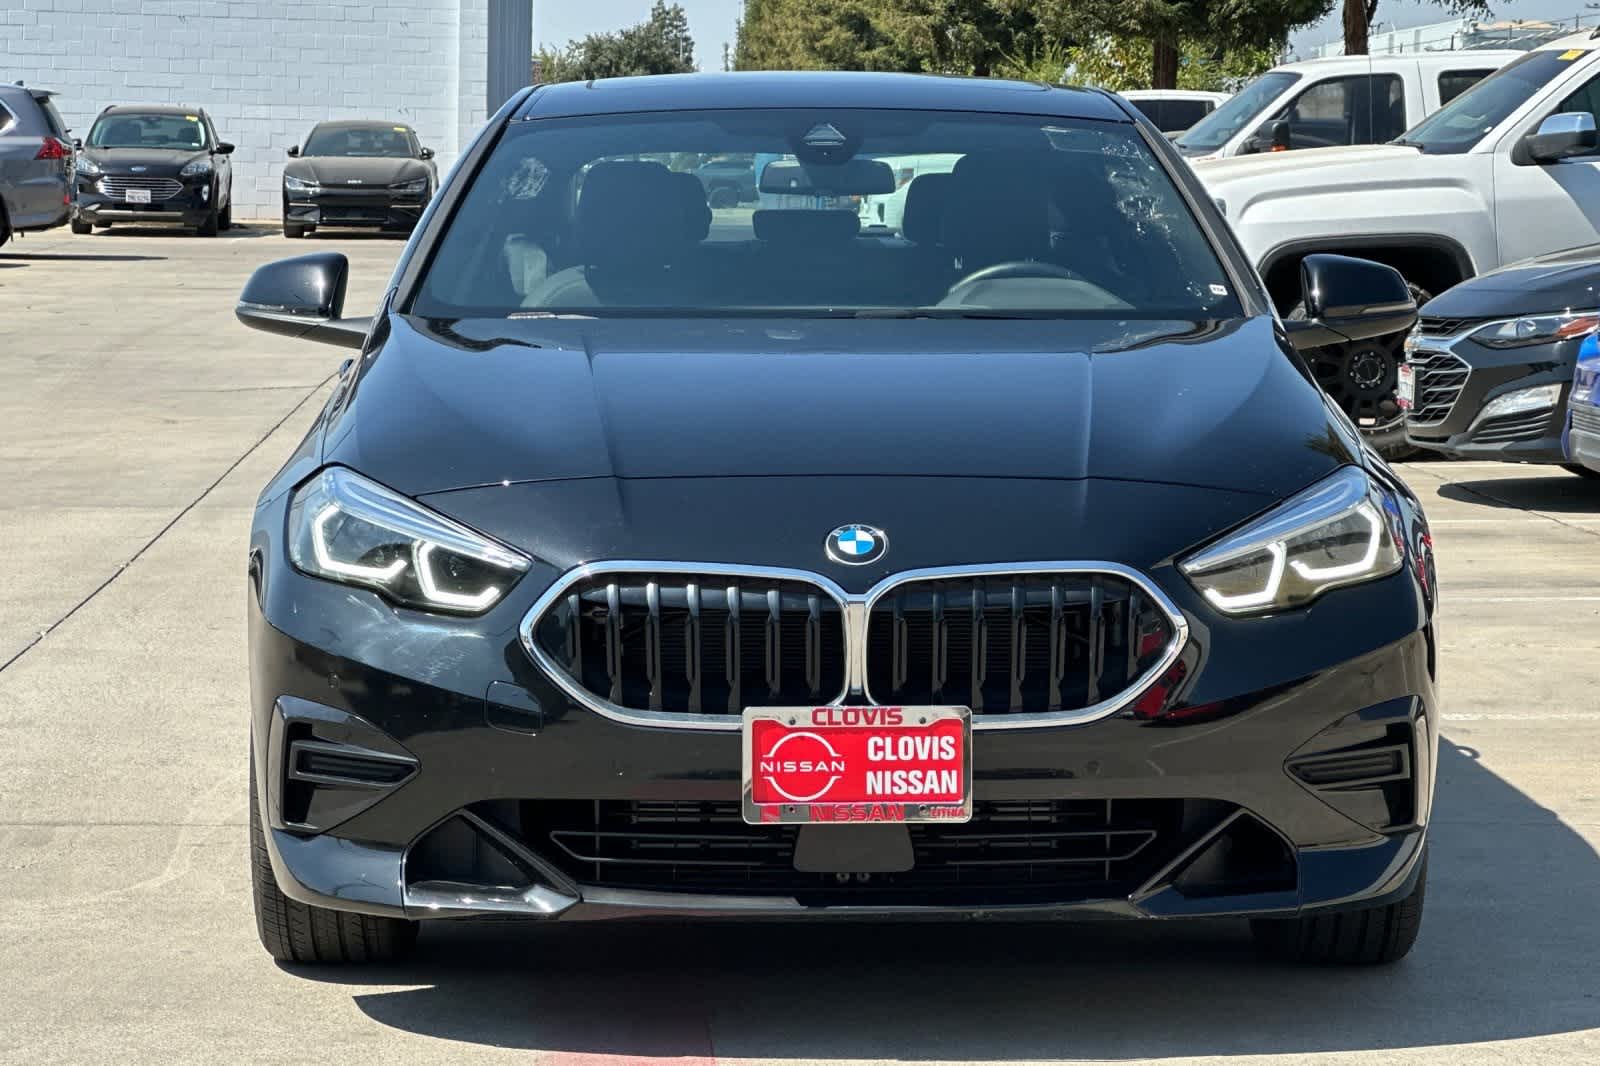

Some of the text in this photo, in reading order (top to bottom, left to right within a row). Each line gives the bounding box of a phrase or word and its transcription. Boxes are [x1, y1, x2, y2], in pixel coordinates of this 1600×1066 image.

[812, 707, 903, 726] CLOVIS
[867, 736, 956, 761] CLOVIS
[759, 761, 845, 772] NISSAN
[866, 770, 957, 795] NISSAN
[808, 804, 905, 821] NISSAN
